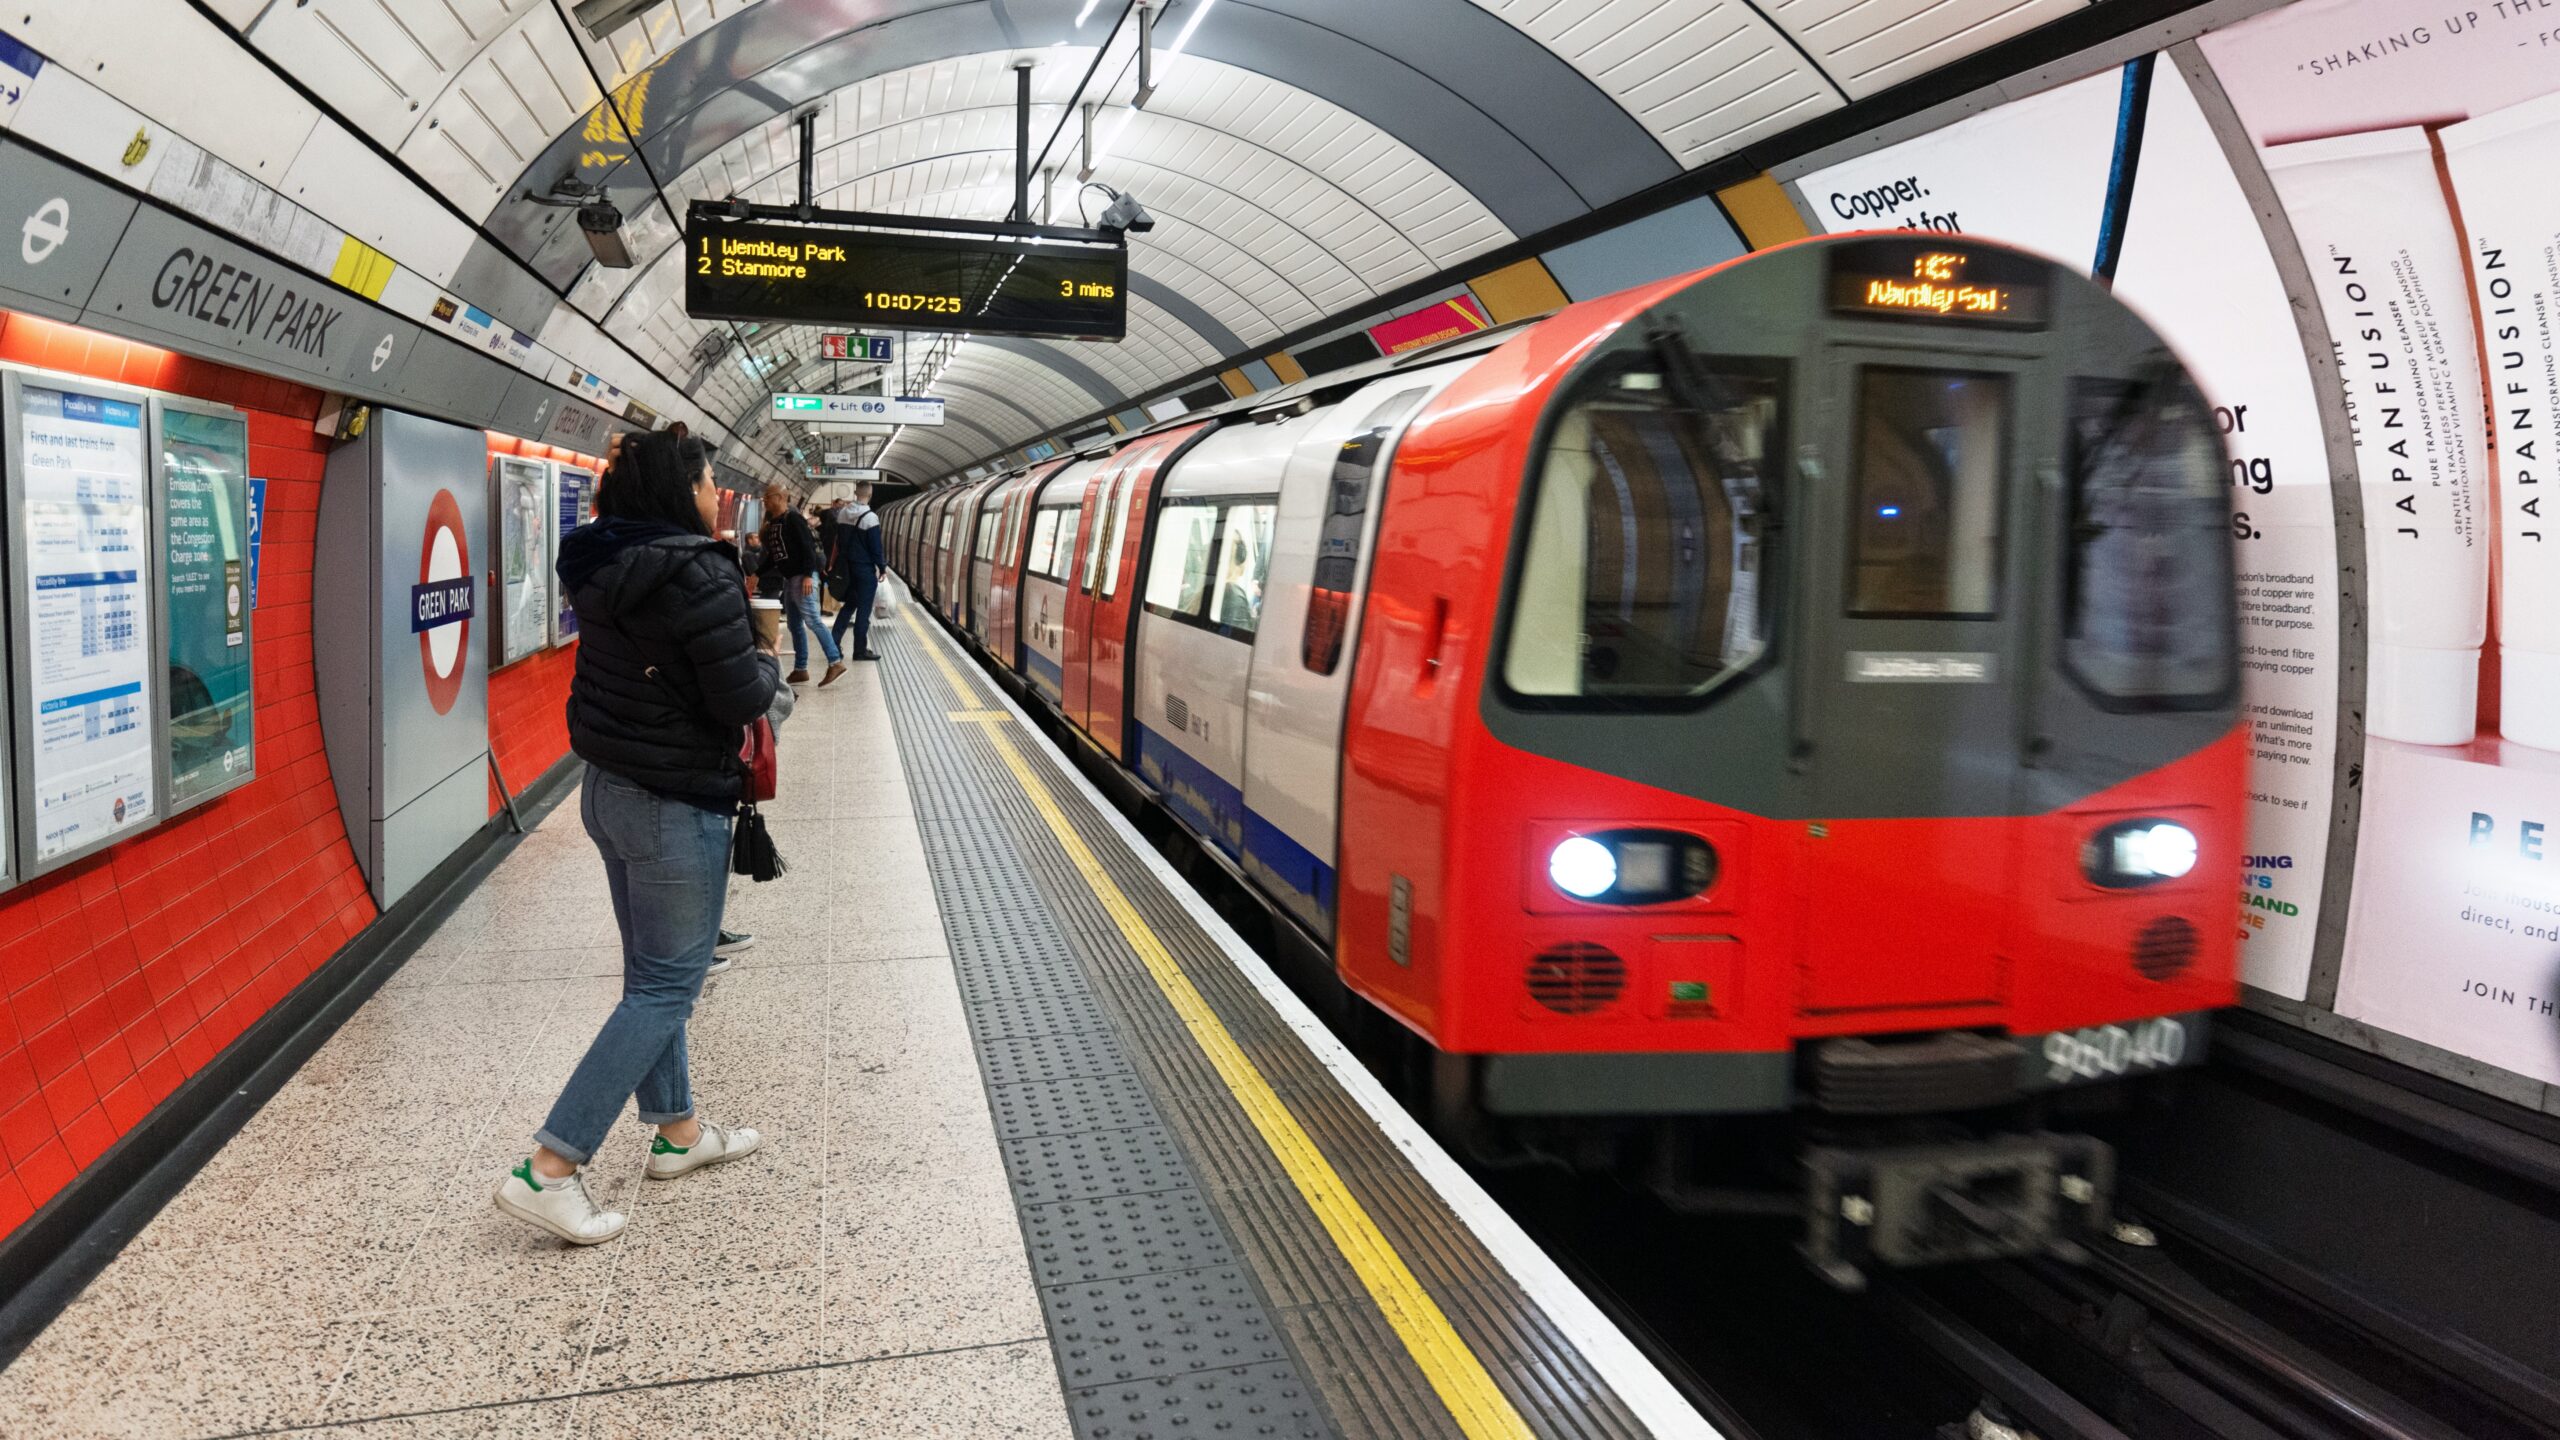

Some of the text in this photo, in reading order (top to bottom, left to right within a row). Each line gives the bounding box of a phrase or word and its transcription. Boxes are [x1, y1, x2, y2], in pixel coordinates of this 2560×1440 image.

[2445, 11, 2478, 34] UP
[1830, 175, 1930, 220] Copper.
[1920, 211, 1962, 235] for
[702, 236, 846, 262] 1 Wembley Park
[698, 256, 1114, 298] 2 Stanmore 3 mins
[2398, 249, 2433, 317] POLYPHENOLS
[2391, 260, 2419, 316] CLEANSING
[152, 247, 343, 358] GREEN PARK
[864, 293, 961, 313] 10:07:25
[2534, 292, 2552, 350] CLEANSER
[2415, 320, 2434, 361] MAKEUP
[2428, 320, 2444, 354] GRAPE
[2333, 341, 2347, 366] PIE
[2440, 358, 2448, 366] &
[2442, 370, 2451, 378] C
[2388, 300, 2441, 486] PURE TRANSFORMING CLEANSER
[2429, 367, 2446, 411] PERFECT
[840, 402, 858, 411] Lift
[2445, 381, 2461, 429] VITAMIN
[30, 431, 48, 446] First
[50, 435, 63, 447] and
[65, 436, 78, 449] last
[80, 437, 98, 450] trains
[2441, 416, 2456, 473] TRACELESS
[32, 453, 72, 469] Green Park
[2454, 434, 2471, 511] ANTIOXIDANT
[169, 477, 213, 493] Emission Zone
[170, 499, 202, 509] covers the
[2452, 491, 2463, 534] GENTLE
[170, 516, 209, 527] same area as
[171, 531, 215, 548] the Congestion
[171, 550, 192, 565] Charge
[2236, 573, 2314, 584] ndon's broadband
[2251, 587, 2260, 596] of
[2262, 589, 2293, 599] copper
[2295, 589, 2314, 599] wire
[418, 586, 470, 621] GREEN PARK
[2251, 616, 2260, 626] fit
[2261, 617, 2273, 627] for
[2275, 620, 2315, 630] purpose.
[2292, 649, 2315, 660] fibre
[2281, 664, 2314, 675] copper
[2252, 705, 2268, 714] and
[2269, 706, 2314, 720] download
[2256, 721, 2267, 729] an
[2270, 722, 2313, 735] unlimited
[2255, 733, 2285, 747] What's
[2287, 740, 2312, 750] more
[2257, 750, 2287, 763] paying
[2289, 754, 2311, 766] now.
[2271, 795, 2280, 806] to
[2282, 798, 2299, 809] see
[2301, 800, 2308, 810] if
[2240, 855, 2293, 868] DING
[2239, 891, 2299, 917] BAND
[2239, 910, 2266, 930] HE
[2461, 905, 2560, 942] direct, and
[2462, 979, 2560, 1020] JOIN TH
